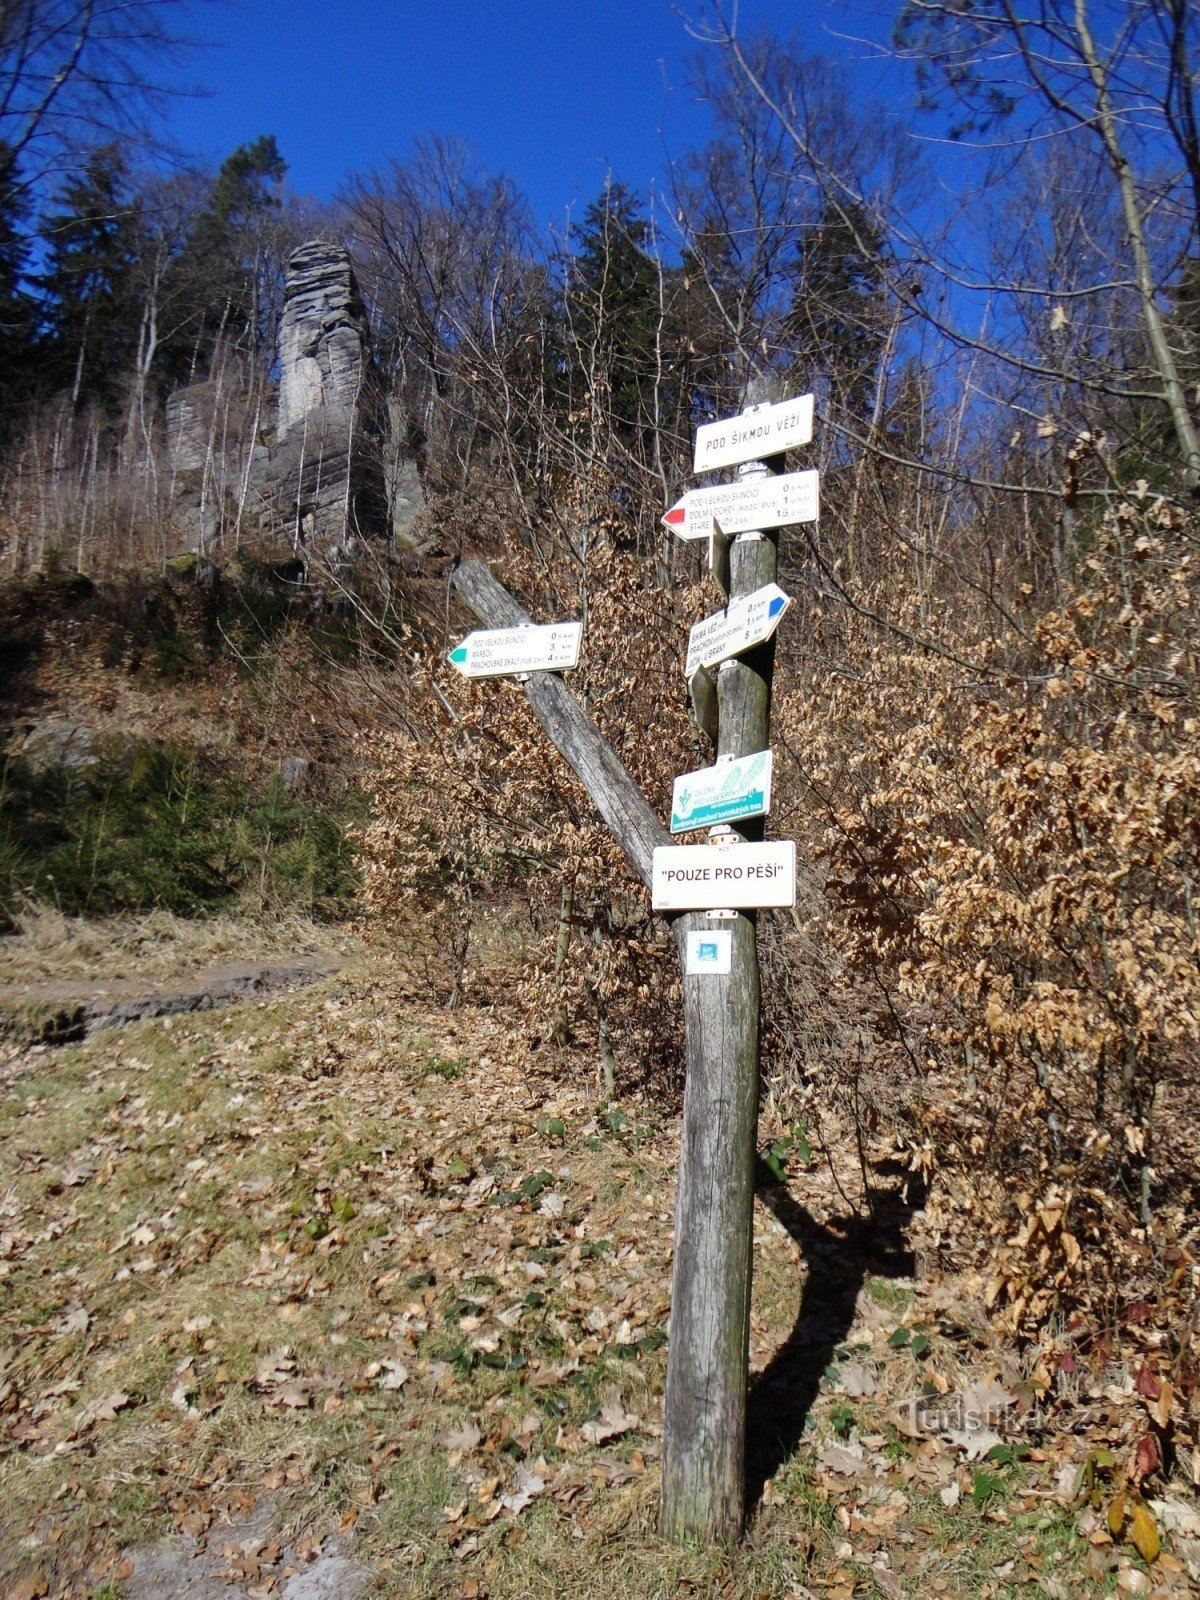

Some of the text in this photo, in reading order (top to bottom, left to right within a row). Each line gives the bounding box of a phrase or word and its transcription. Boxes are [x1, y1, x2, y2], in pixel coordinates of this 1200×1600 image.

[706, 437, 726, 452] POD
[731, 424, 770, 445] ŠIKMOU
[776, 412, 801, 432] VĚŽÍ
[689, 498, 704, 508] POD
[704, 492, 731, 505] VELKOU
[689, 508, 709, 520] DOLNÍ
[709, 504, 736, 516] LOCHOV
[473, 640, 484, 648] POD
[484, 637, 503, 647] VELKOU
[549, 643, 556, 651] 3
[504, 657, 520, 667] SKÁLY
[662, 862, 784, 882] "POUZE PRO PĚŠÍ"
